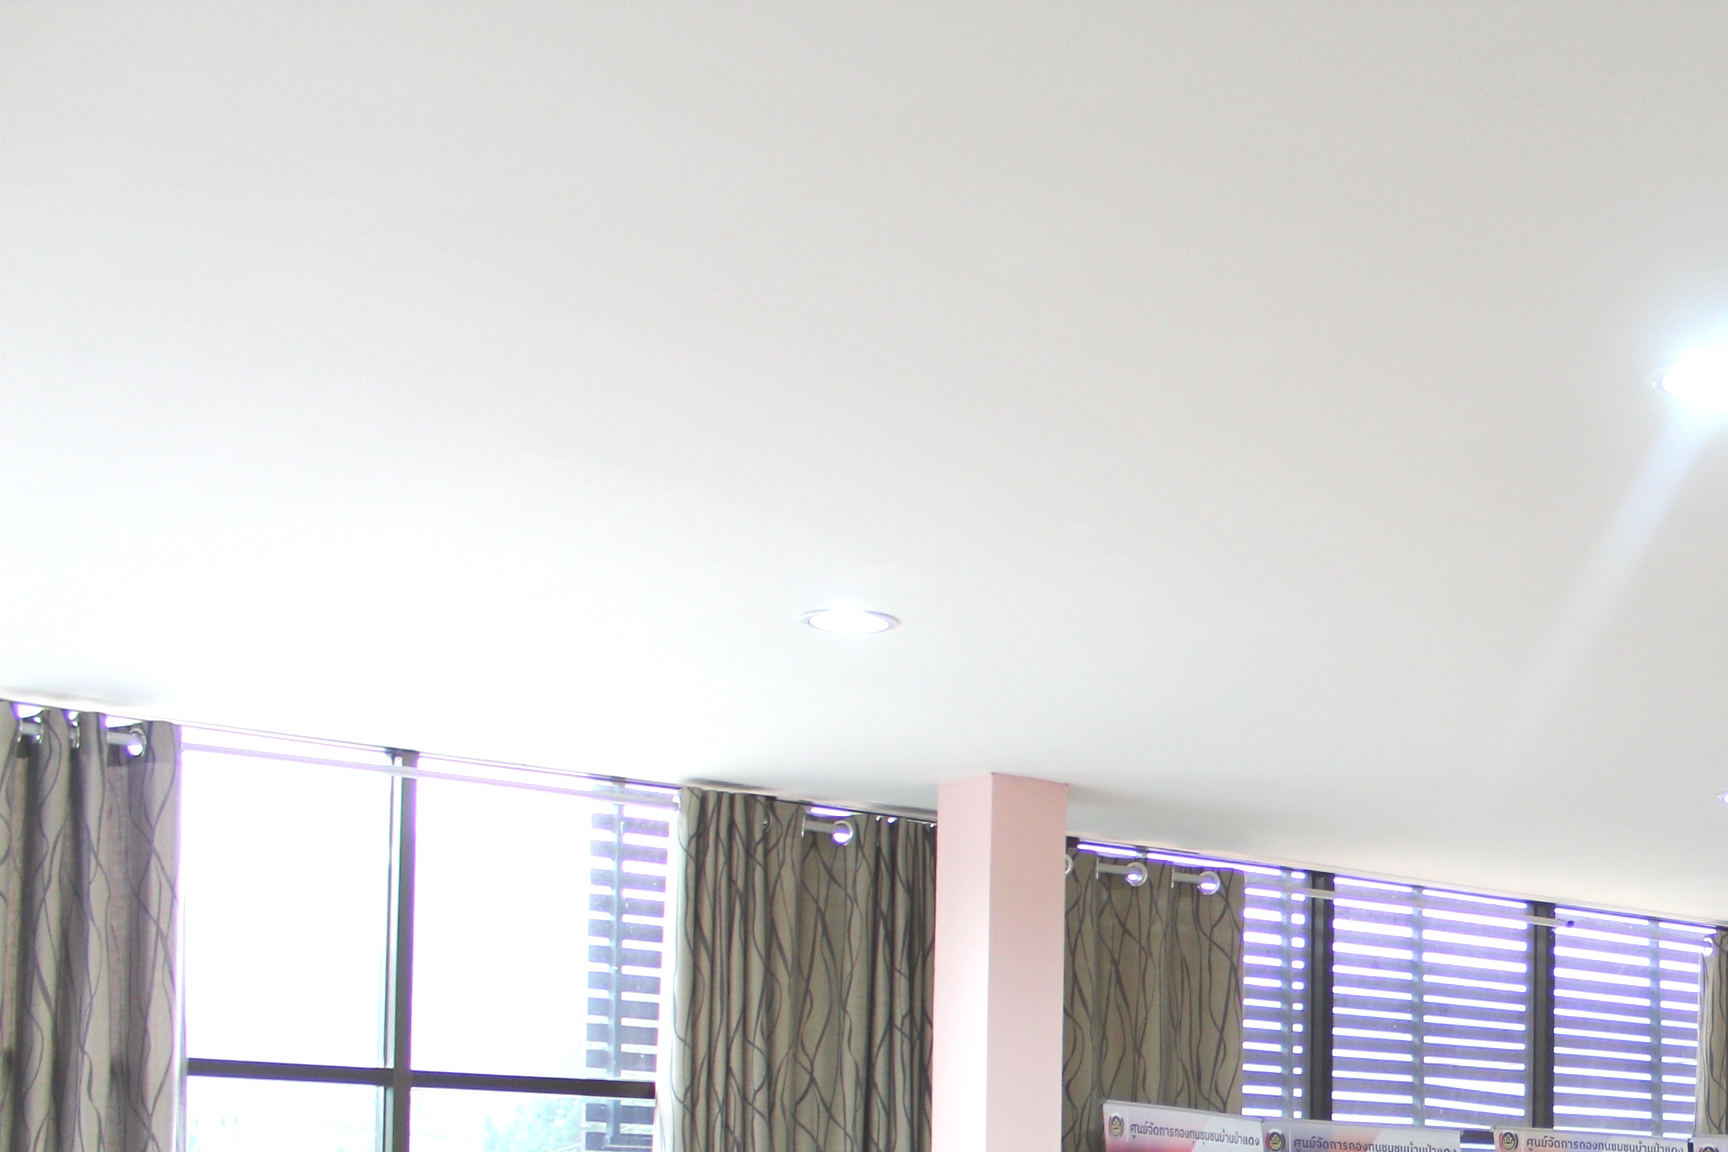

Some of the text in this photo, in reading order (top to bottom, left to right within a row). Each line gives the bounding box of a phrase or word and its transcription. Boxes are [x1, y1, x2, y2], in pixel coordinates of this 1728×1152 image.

[1130, 1121, 1260, 1146] ศูนย์จัดการกองทุนชุมชนบ้านป่าแดง
